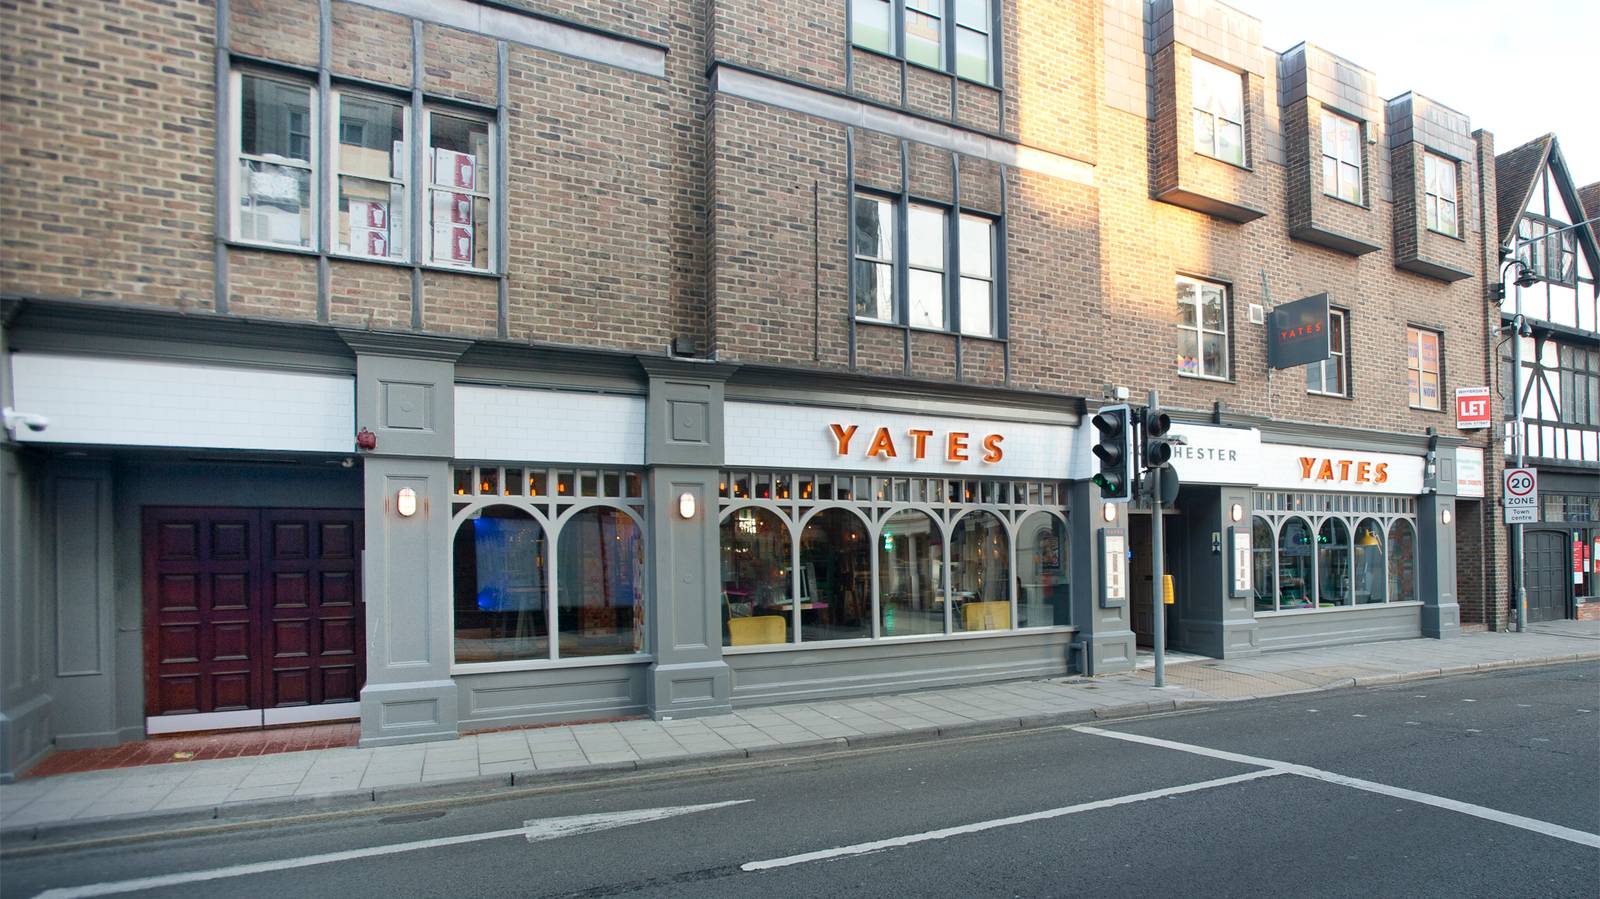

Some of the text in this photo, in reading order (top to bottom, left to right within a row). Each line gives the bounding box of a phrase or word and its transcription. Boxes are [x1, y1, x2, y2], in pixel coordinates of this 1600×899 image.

[1281, 322, 1321, 338] YATES
[1461, 400, 1486, 416] LET
[828, 424, 1005, 465] YATES
[1174, 447, 1237, 461] HESTER
[1300, 457, 1389, 484] YATES
[1511, 477, 1531, 489] 20
[1508, 497, 1535, 505] ZONE
